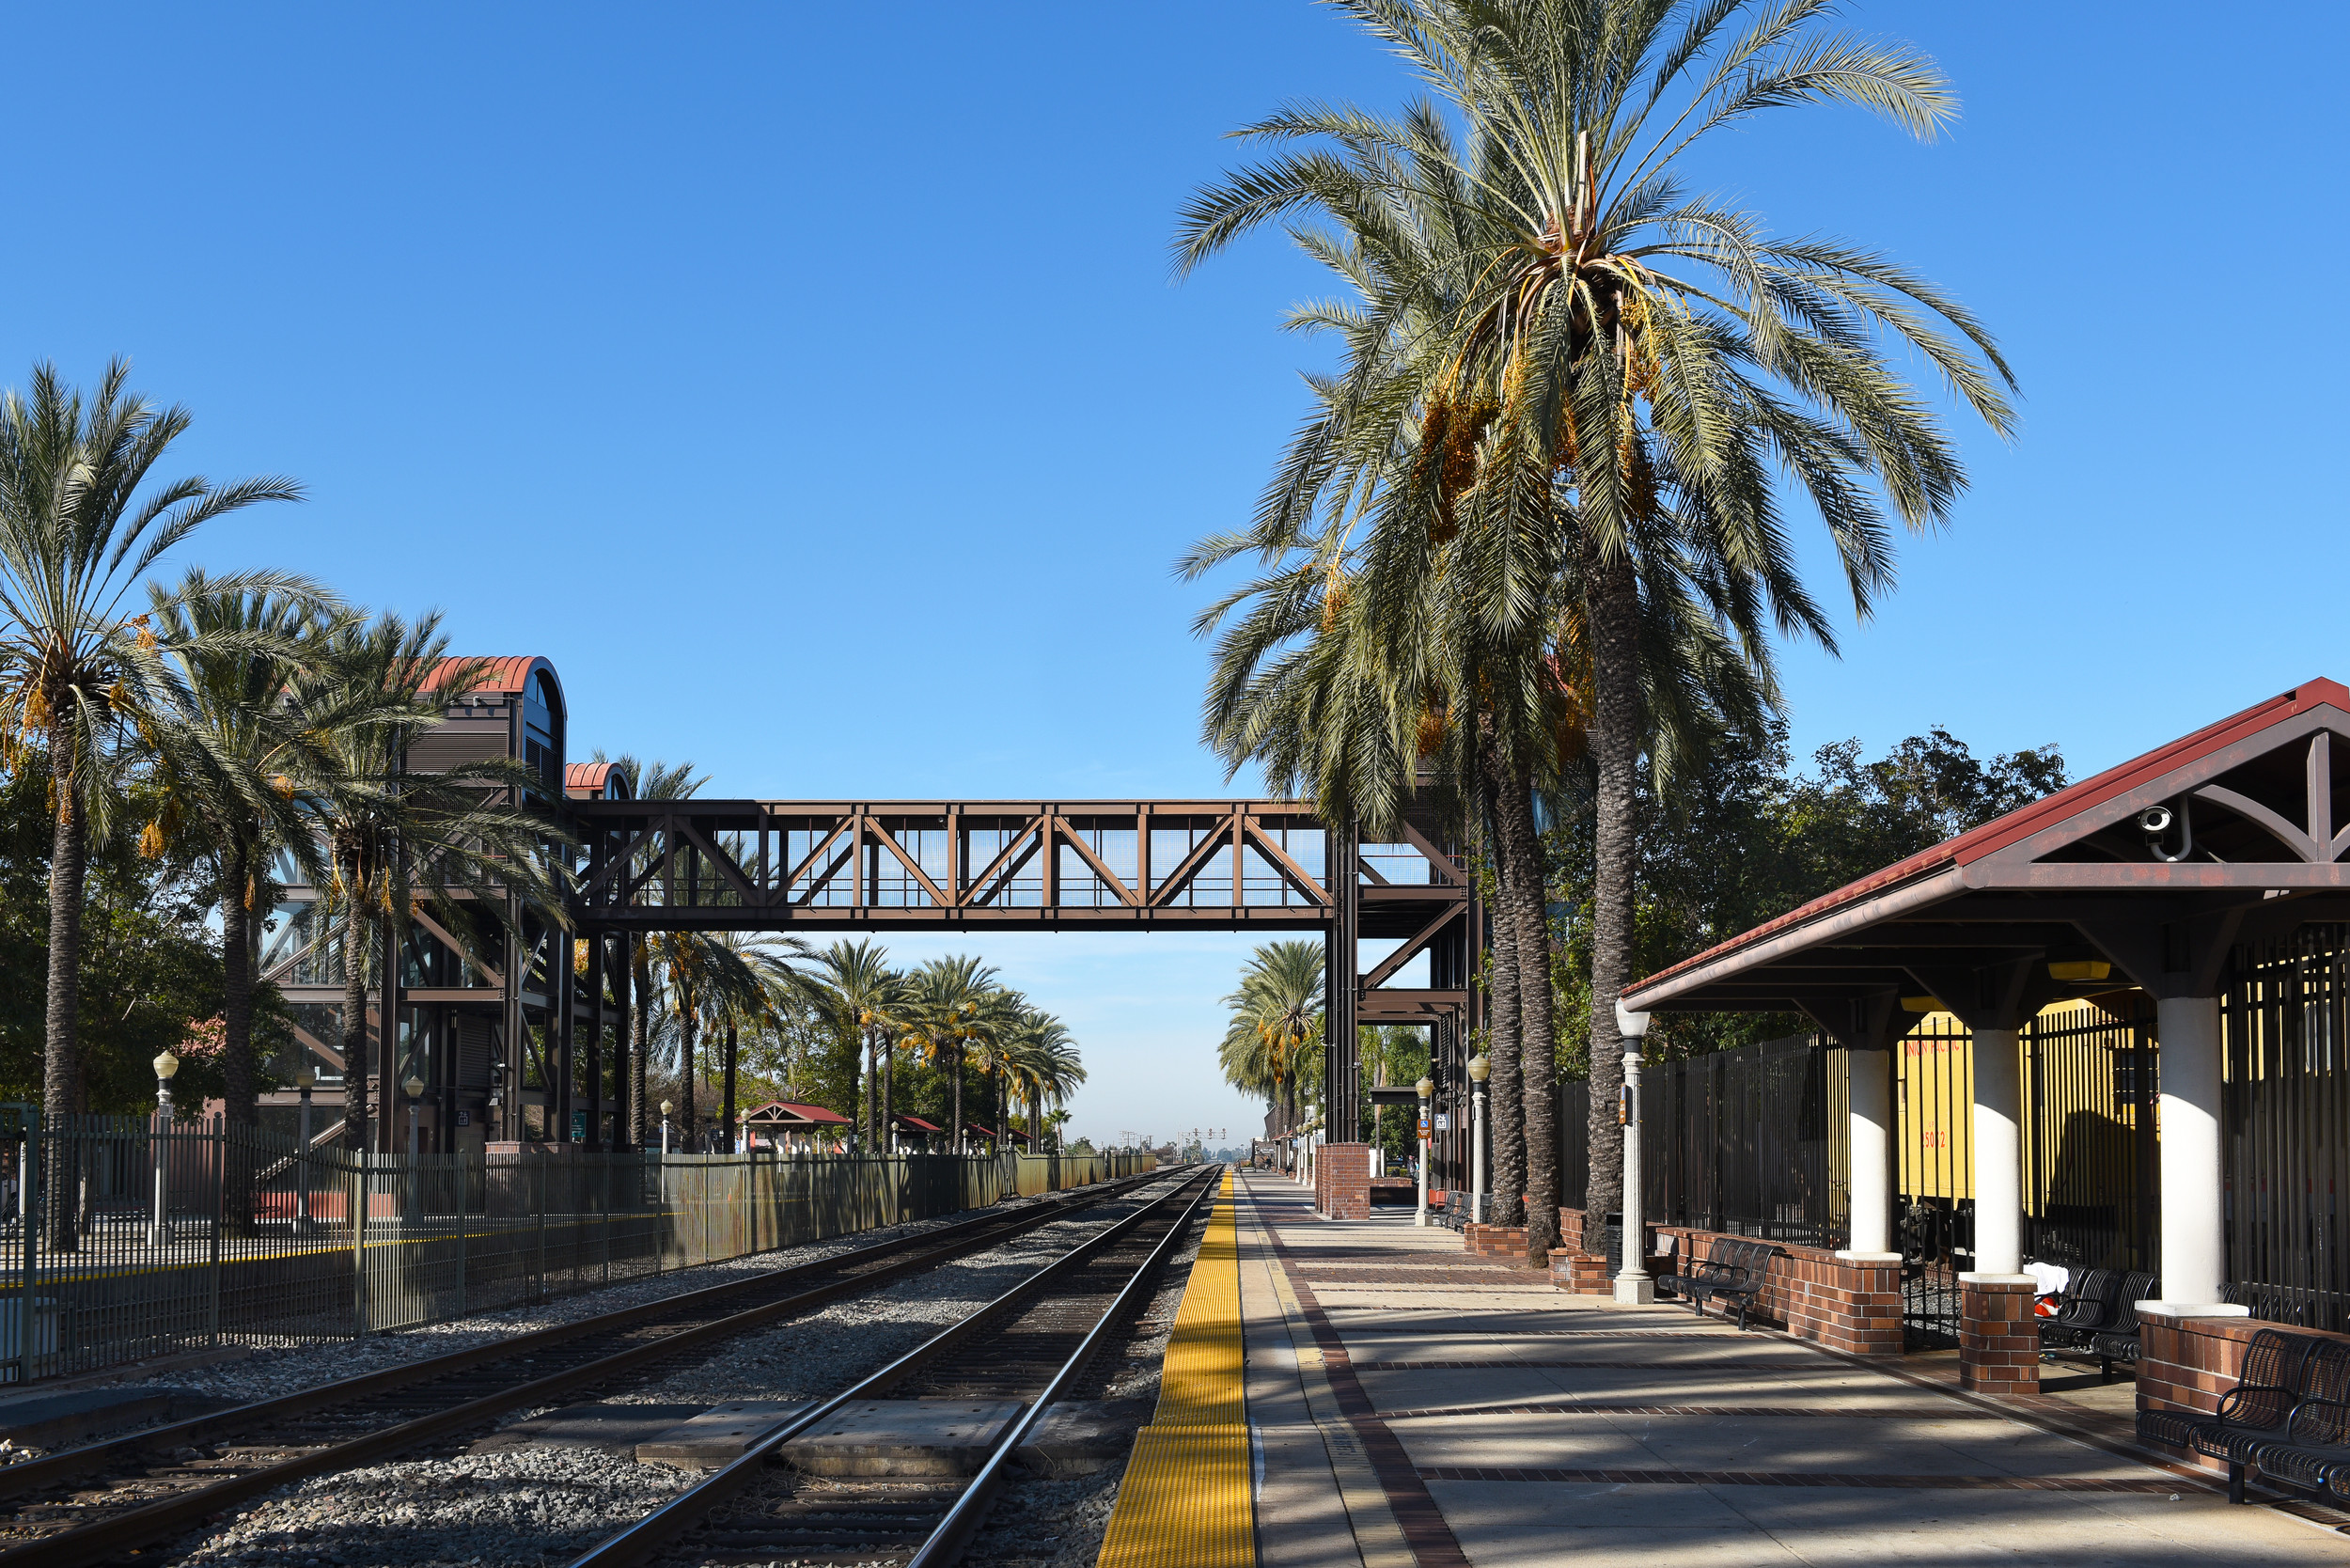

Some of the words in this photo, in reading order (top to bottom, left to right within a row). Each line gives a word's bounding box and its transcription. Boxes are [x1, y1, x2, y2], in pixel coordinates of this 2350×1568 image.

[1904, 1037, 1928, 1057] UNION
[1931, 1034, 1960, 1054] PACIIC
[1920, 1130, 1946, 1148] 502
